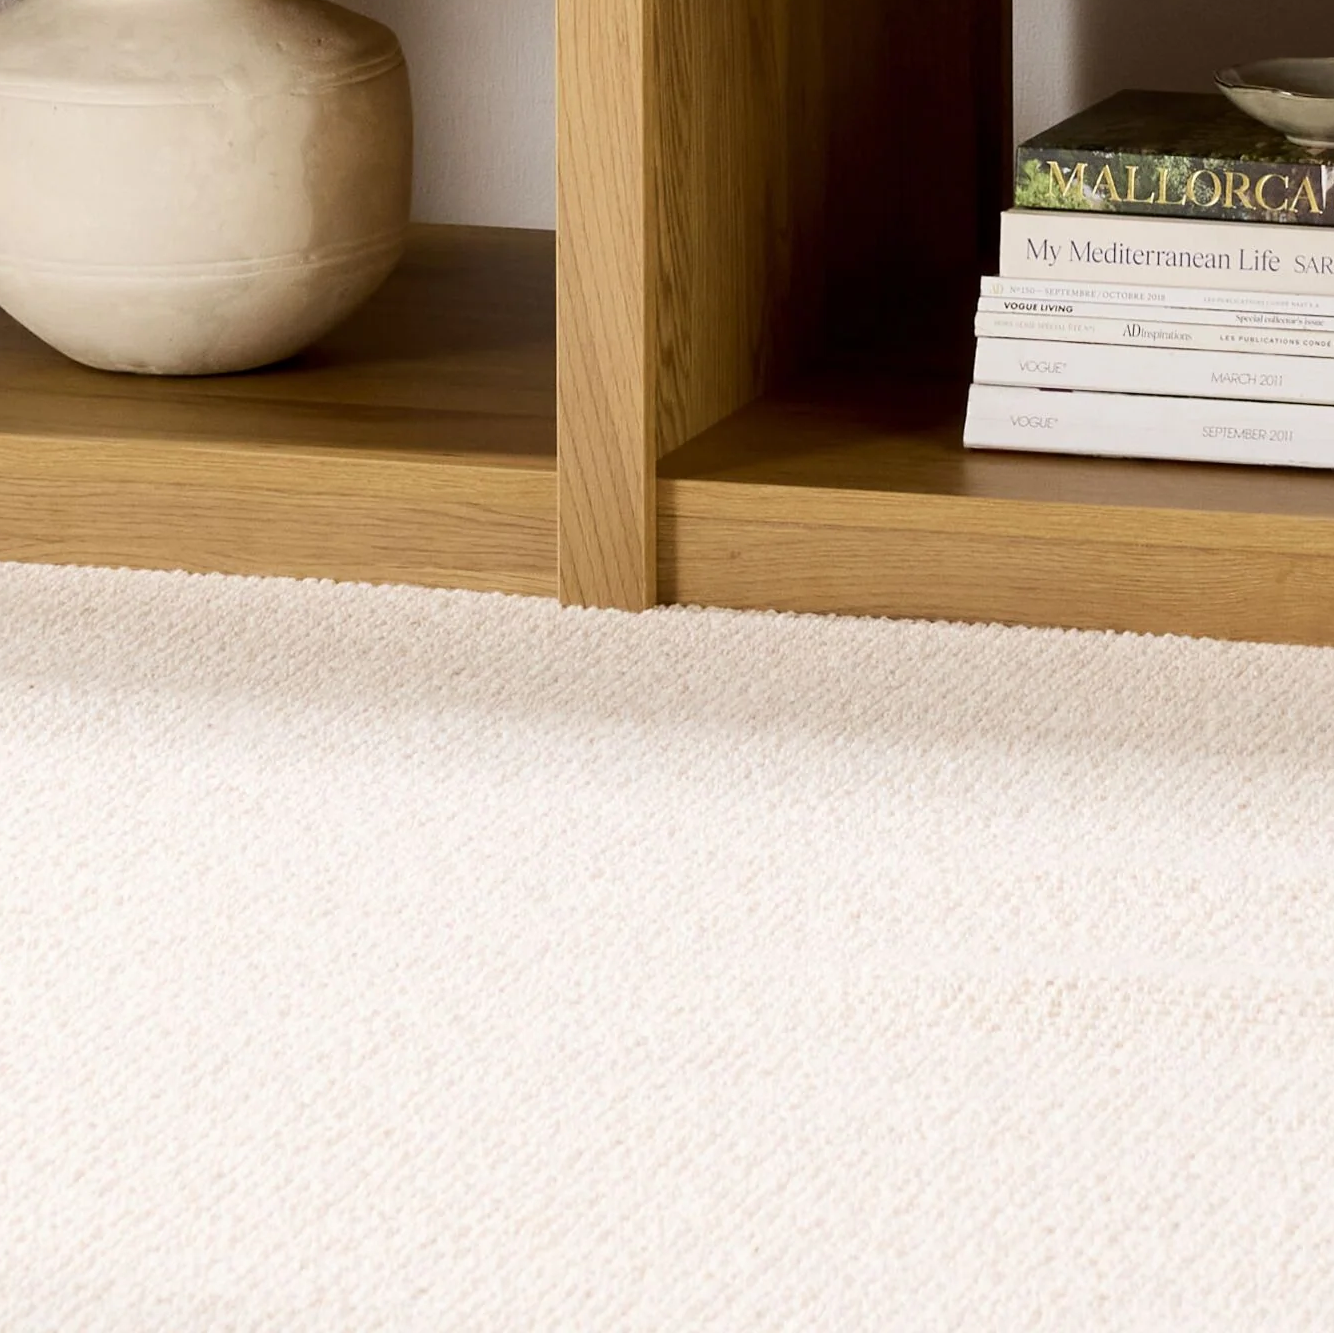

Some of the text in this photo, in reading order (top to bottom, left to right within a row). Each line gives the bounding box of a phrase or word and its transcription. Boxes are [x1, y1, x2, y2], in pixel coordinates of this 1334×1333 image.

[1046, 160, 1322, 214] MALLORCA
[1026, 237, 1061, 267] My
[1069, 239, 1230, 270] Mediterranean
[1239, 248, 1280, 272] Life
[1004, 301, 1074, 314] VOGUE LIVING
[1236, 314, 1264, 326] Special
[1239, 335, 1300, 346] PUBLICATIONS
[1303, 338, 1332, 348] CONDÉ
[1211, 372, 1257, 386] MARCH
[1260, 374, 1284, 386] 2011
[1202, 426, 1267, 441] SEPTEMBER
[1270, 429, 1295, 442] 2011
